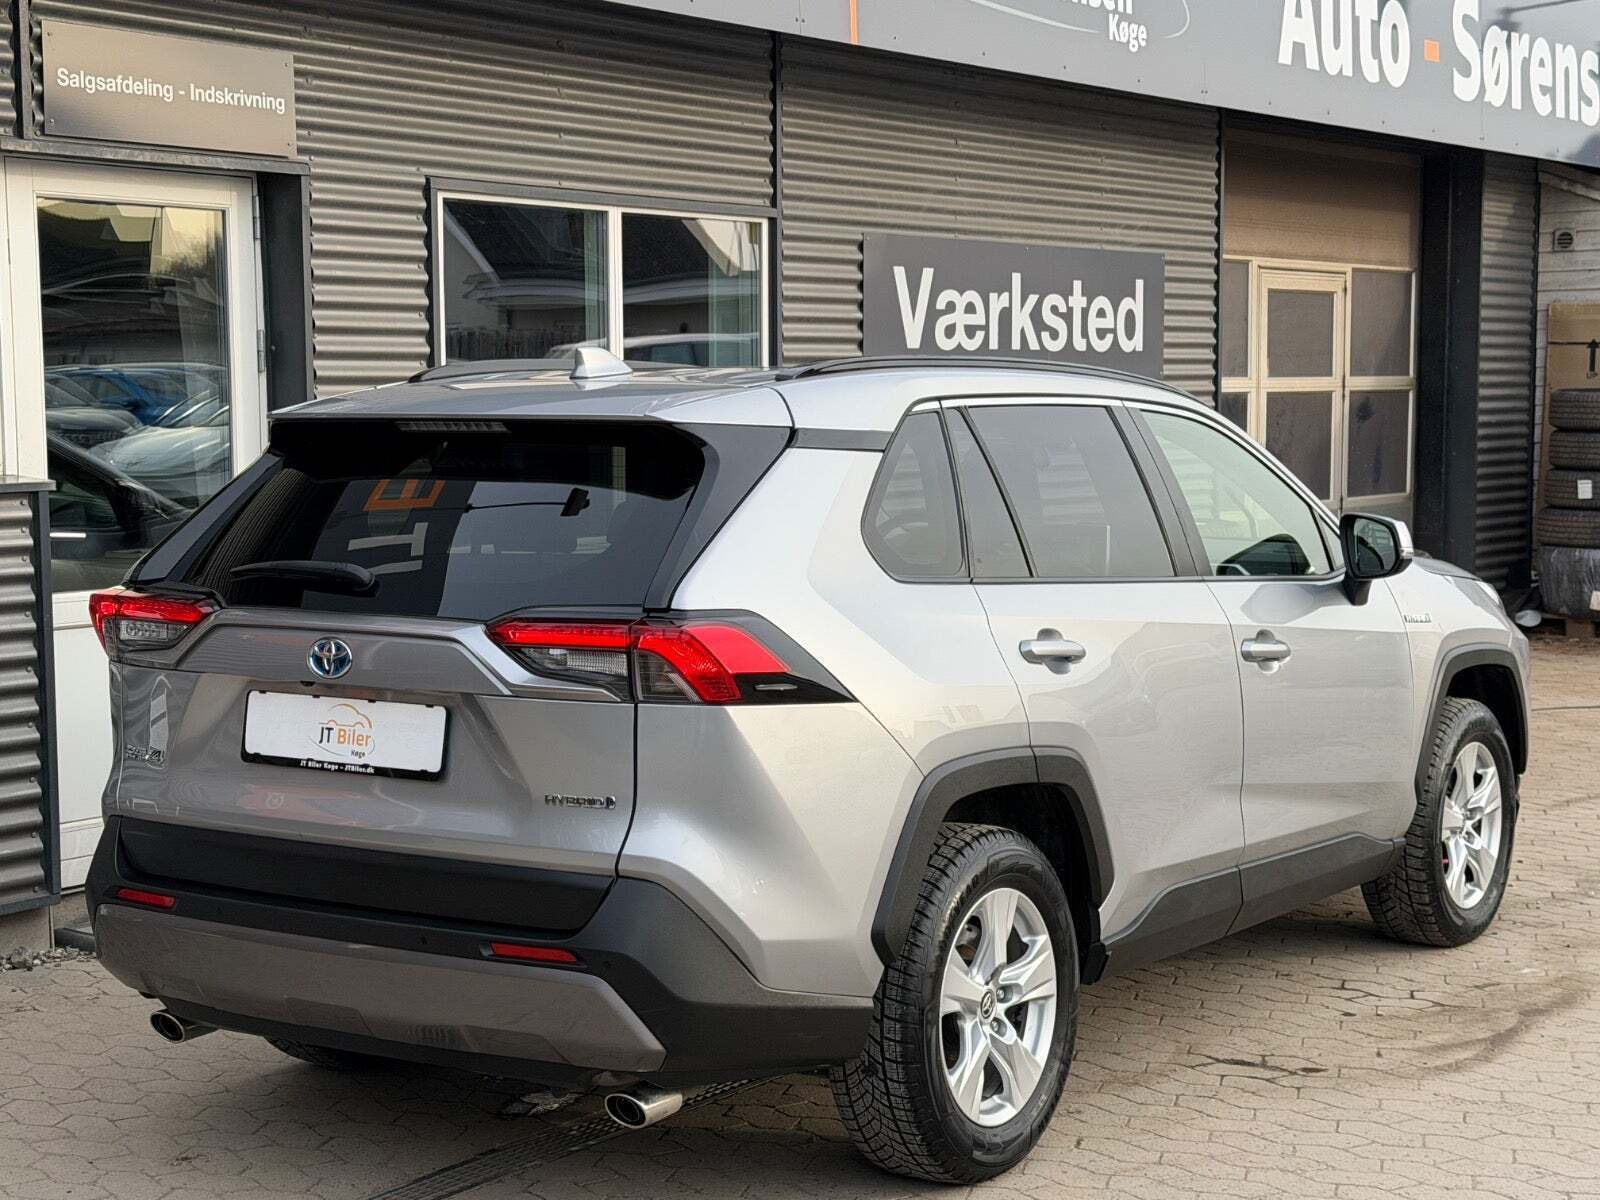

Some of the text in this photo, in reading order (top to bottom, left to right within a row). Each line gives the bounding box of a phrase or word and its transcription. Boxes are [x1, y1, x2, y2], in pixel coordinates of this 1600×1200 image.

[1108, 13, 1148, 52] Køge
[1278, 0, 1411, 88] Auto
[56, 67, 174, 102] Salgsafdeling
[190, 83, 286, 114] Indskrivning
[893, 265, 1144, 353] Værksted
[318, 726, 371, 747] JT Biler
